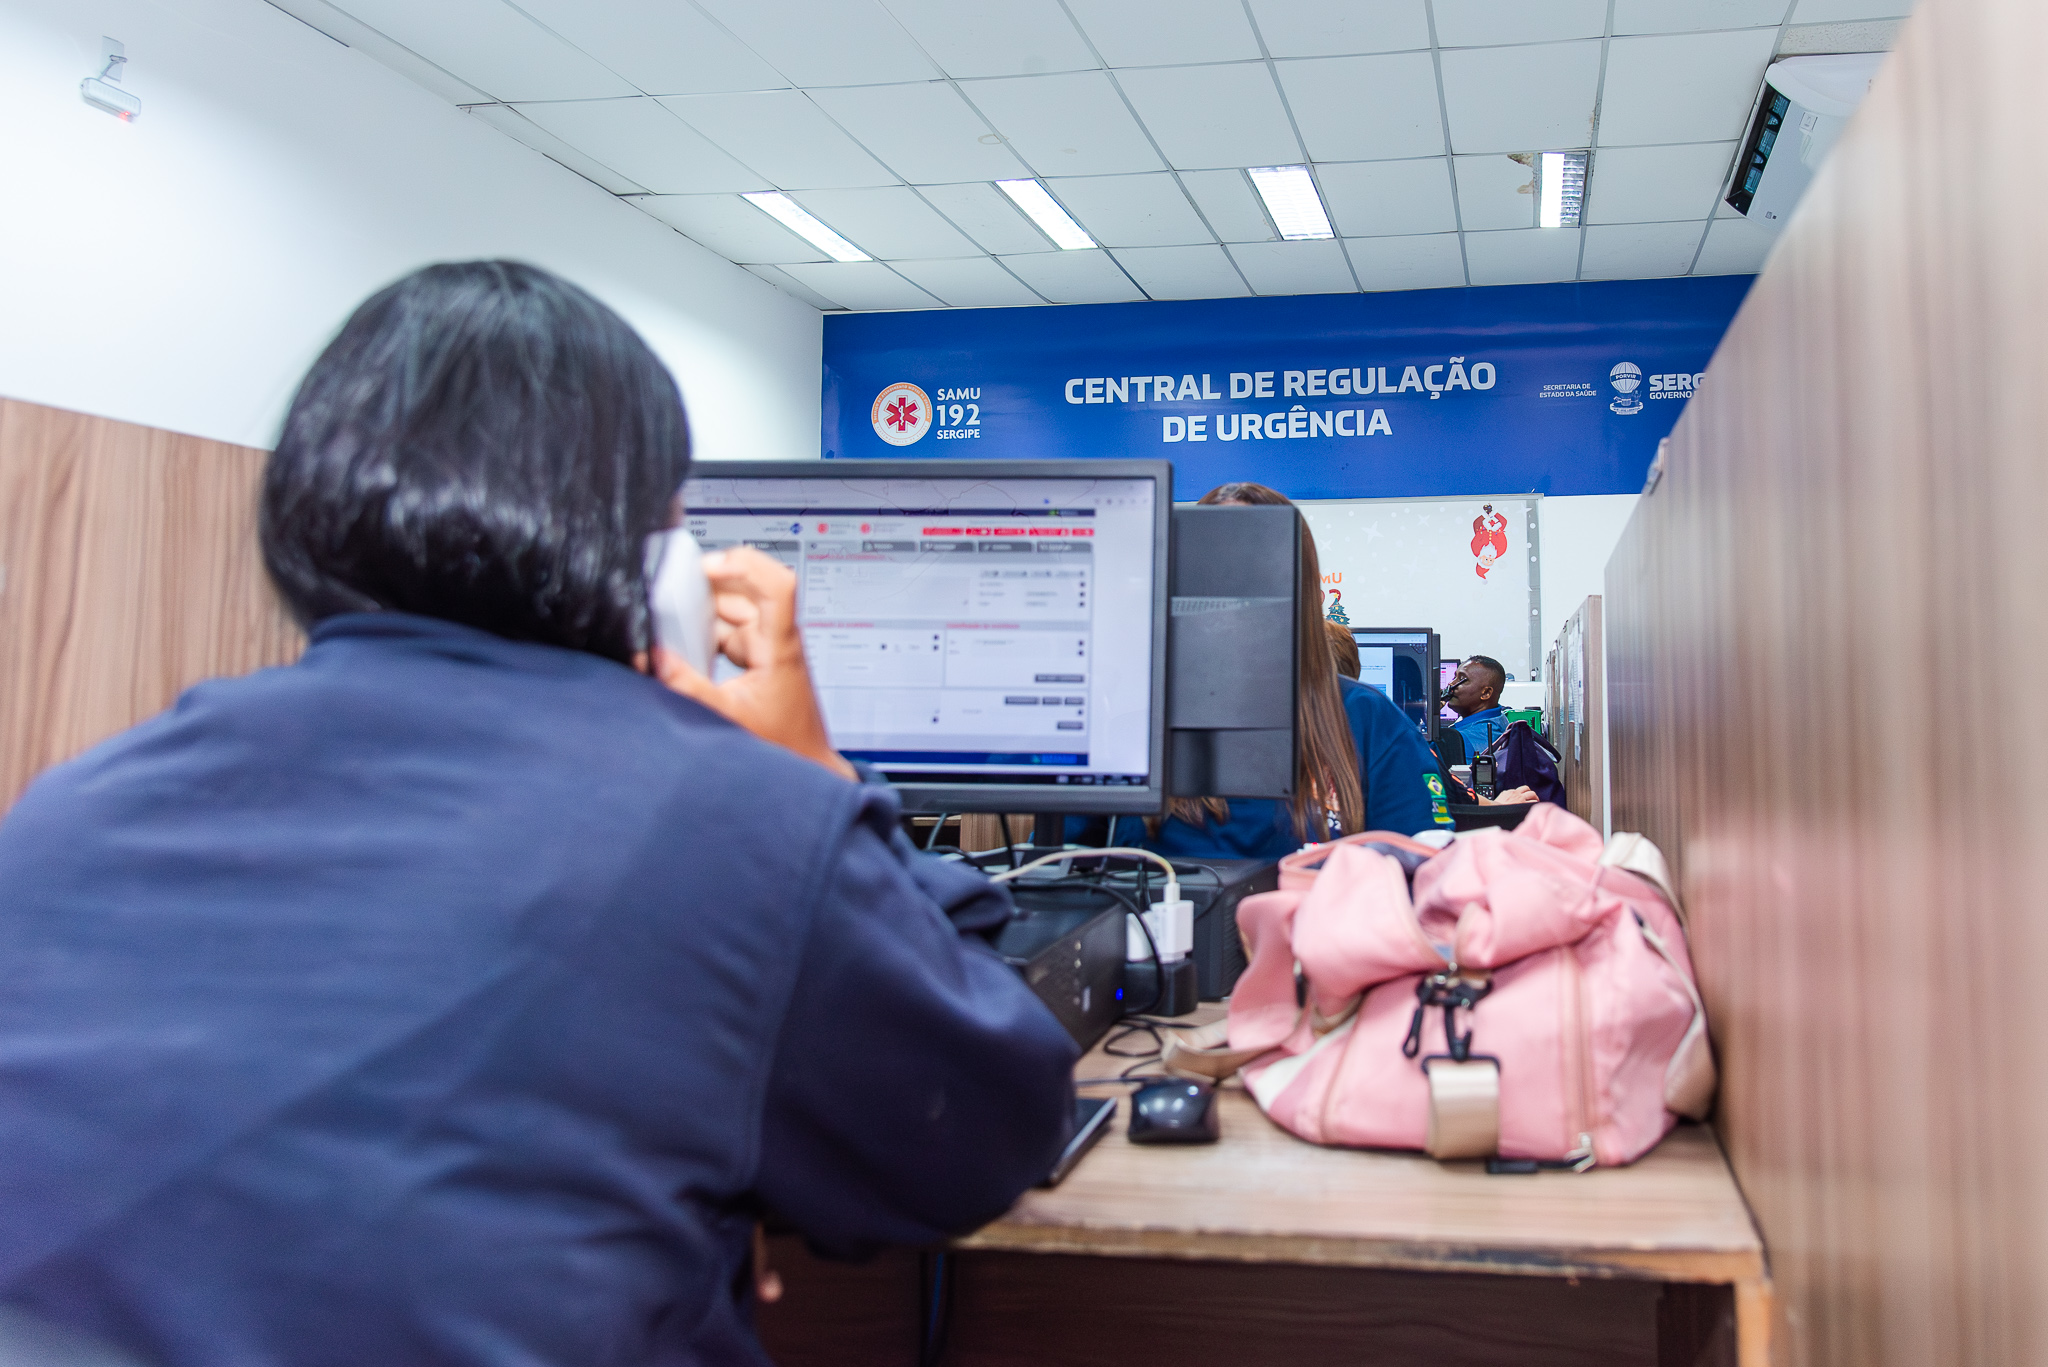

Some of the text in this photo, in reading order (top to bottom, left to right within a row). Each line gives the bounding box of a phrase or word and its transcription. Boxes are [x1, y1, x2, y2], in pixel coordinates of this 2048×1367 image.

[1064, 356, 1496, 405] CENTRAL DE REGULAÇÃO
[1543, 383, 1581, 391] SECRETARIA
[1649, 372, 1706, 392] SERG
[937, 387, 981, 401] SAMU
[1575, 389, 1597, 397] SAÚDE
[1649, 390, 1692, 400] GOVERNO
[936, 403, 981, 427] 192
[1162, 404, 1393, 443] DE URGÊNCIA
[936, 428, 981, 440] SERGIPE
[1319, 572, 1343, 584] MU
